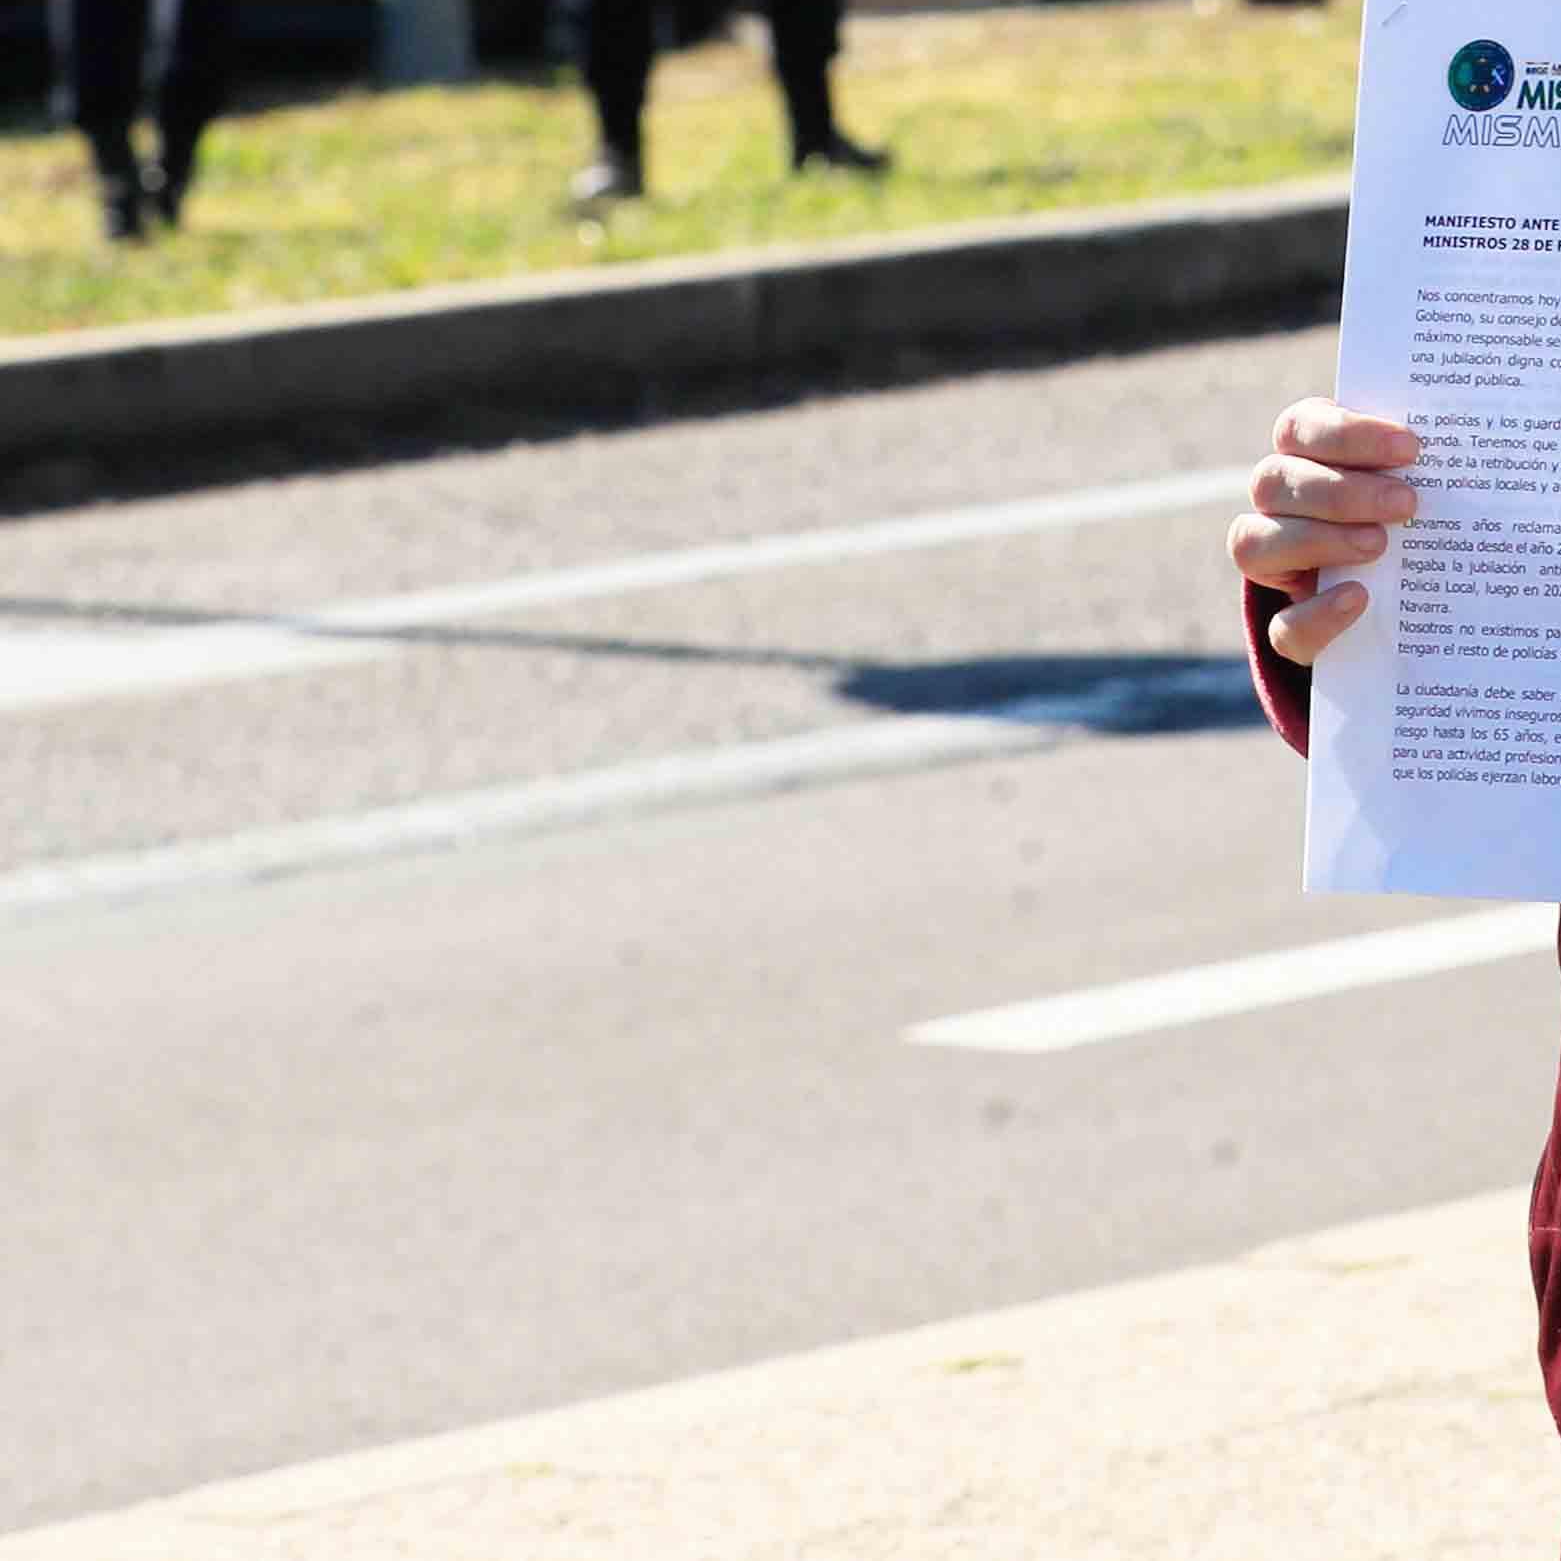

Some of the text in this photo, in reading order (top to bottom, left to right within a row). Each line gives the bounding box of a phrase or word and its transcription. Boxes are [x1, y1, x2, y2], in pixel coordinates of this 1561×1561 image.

[1424, 216, 1517, 229] MANIFIESTO
[1521, 219, 1560, 231] ANTE
[1422, 236, 1508, 250] MINISTROS
[1511, 238, 1531, 250] 28
[1533, 239, 1554, 251] DE
[1416, 289, 1442, 302] Nos
[1443, 291, 1535, 305] concentramos
[1537, 294, 1561, 309] hoy
[1479, 313, 1495, 324] su
[1497, 313, 1548, 329] consejo
[1465, 333, 1543, 347] responsable
[1545, 337, 1561, 347] se
[1411, 353, 1435, 363] una
[1507, 353, 1543, 370] digna
[1409, 372, 1472, 387] seguridad
[1407, 413, 1430, 425] Los
[1500, 415, 1519, 428] los
[1471, 436, 1528, 450] Tenemos
[1531, 440, 1559, 453] que
[1446, 455, 1464, 468] de
[1464, 456, 1478, 468] la
[1406, 475, 1443, 488] hacen
[1494, 478, 1537, 491] locales
[1401, 537, 1475, 552] consolidada
[1476, 539, 1514, 553] desde
[1515, 542, 1528, 554] el
[1401, 558, 1447, 574] llegaba
[1451, 559, 1464, 572] la
[1484, 582, 1520, 598] luego
[1522, 586, 1540, 596] en
[1399, 620, 1454, 634] Nosotros
[1458, 625, 1476, 635] no
[1480, 624, 1540, 638] existimos
[1397, 642, 1440, 657] tengan
[1442, 643, 1456, 655] el
[1457, 645, 1490, 656] resto
[1492, 644, 1509, 657] de
[1396, 683, 1411, 695] La
[1483, 686, 1516, 700] debe
[1521, 688, 1557, 701] saber
[1395, 702, 1453, 720] seguridad
[1454, 706, 1502, 720] vivimos
[1394, 724, 1429, 740] riesgo
[1432, 726, 1466, 739] hasta
[1470, 727, 1489, 740] los
[1492, 728, 1510, 741] 65
[1392, 748, 1419, 761] para
[1421, 750, 1444, 760] una
[1446, 748, 1502, 762] actividad
[1392, 768, 1415, 781] que
[1417, 767, 1434, 780] los
[1481, 769, 1529, 785] ejerzan
